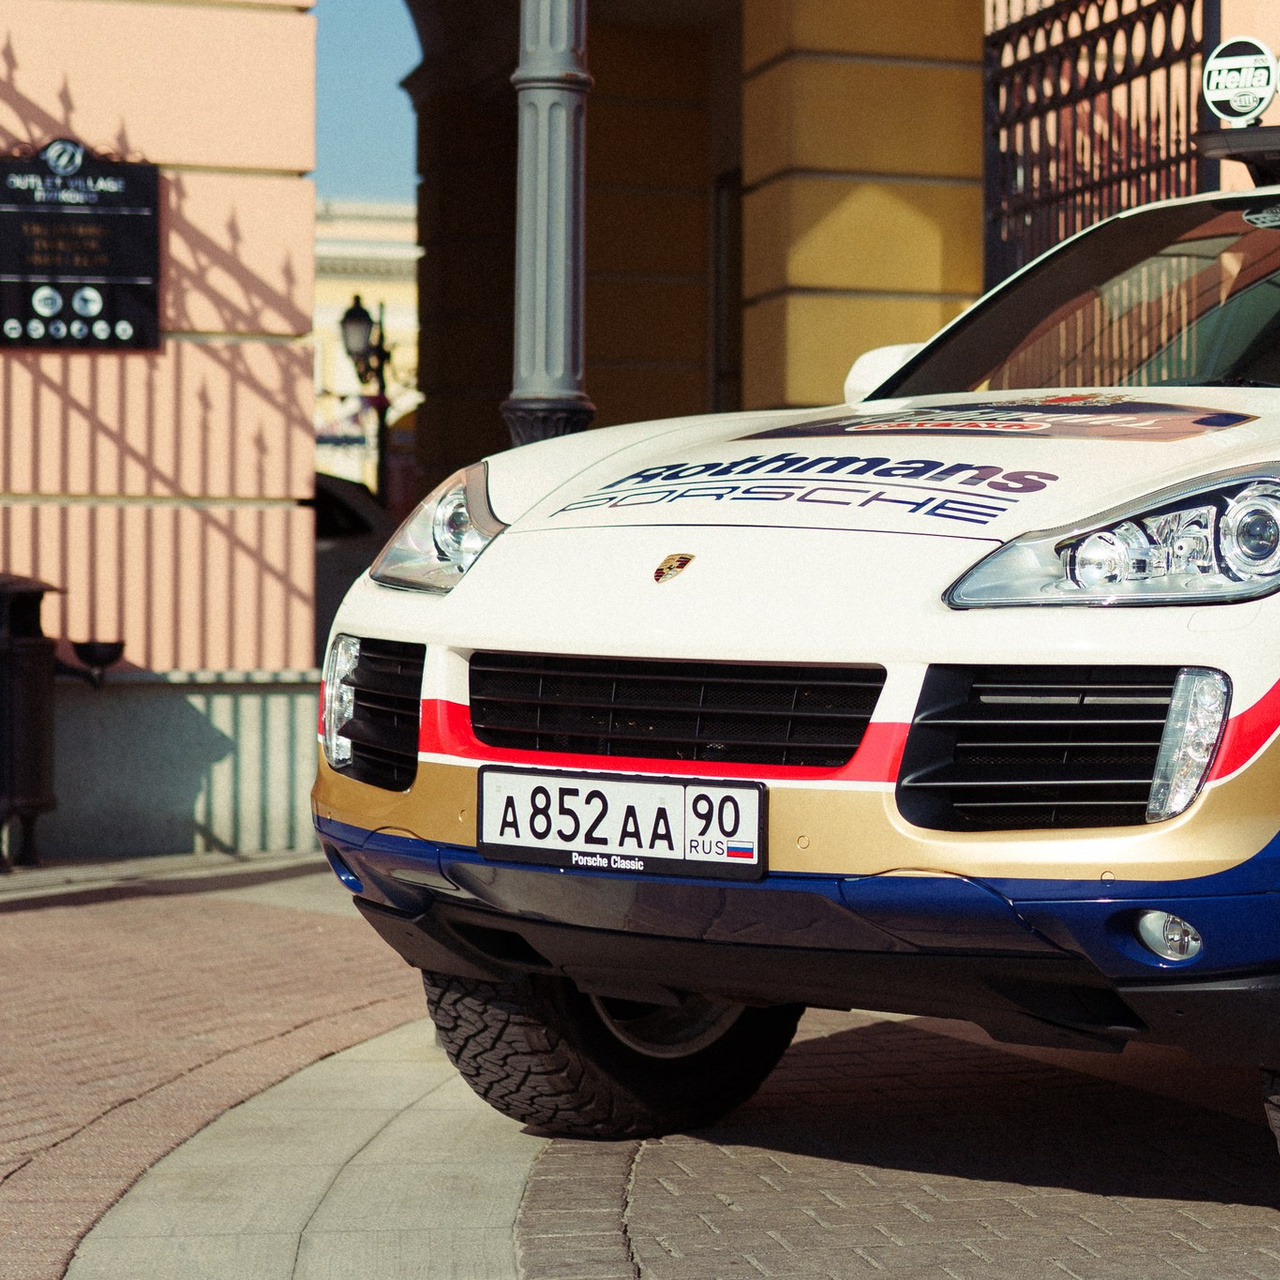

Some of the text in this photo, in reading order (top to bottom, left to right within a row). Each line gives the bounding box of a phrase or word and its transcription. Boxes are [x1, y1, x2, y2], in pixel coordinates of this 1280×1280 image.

[1208, 67, 1269, 91] Hella
[7, 174, 125, 193] OUTLET VILLAGE
[601, 451, 1059, 494] Rothmans
[549, 485, 1008, 525] PORSCHE
[499, 785, 675, 851] A852AA
[691, 793, 741, 838] 90
[572, 852, 645, 871] Porsche Classic
[689, 839, 725, 856] RUS
